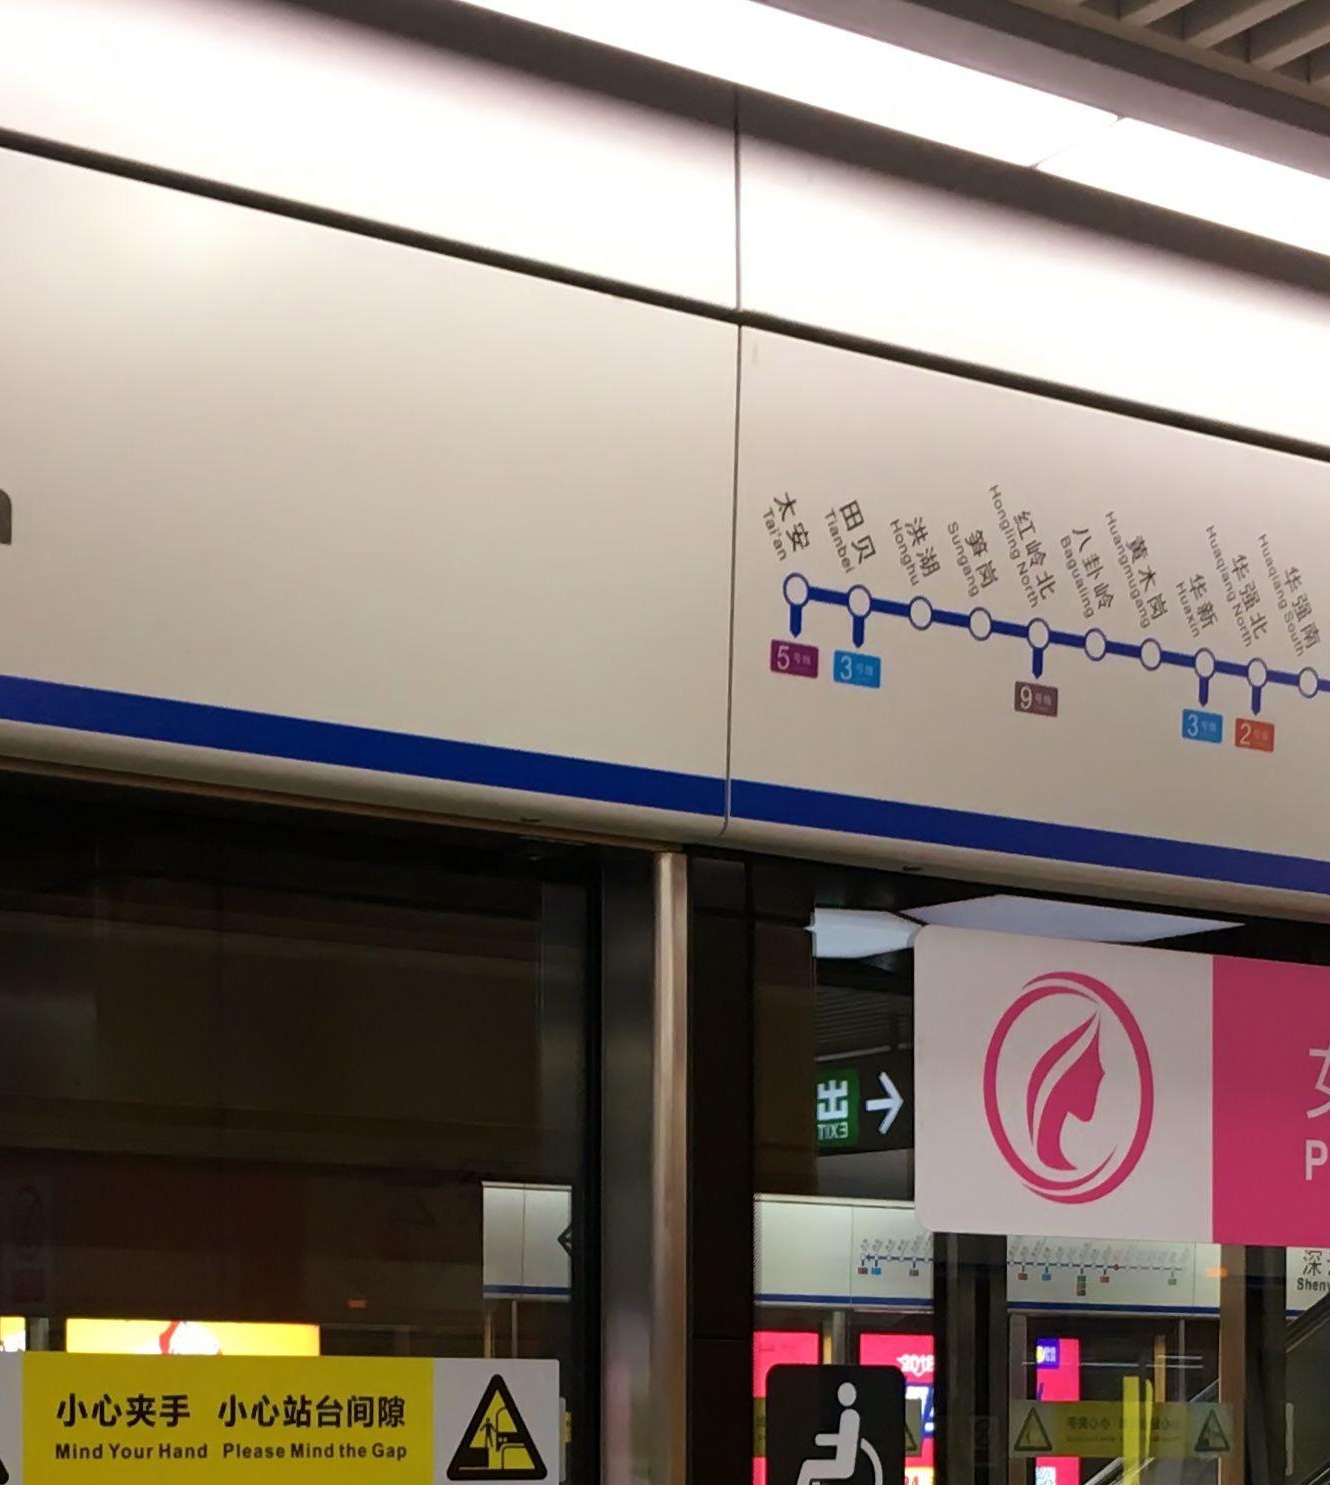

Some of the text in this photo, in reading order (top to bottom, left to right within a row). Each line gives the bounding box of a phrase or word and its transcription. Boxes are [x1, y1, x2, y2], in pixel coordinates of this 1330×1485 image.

[763, 507, 787, 561] Tai'an
[773, 492, 810, 551] 太安
[824, 508, 855, 573] Tianbei
[839, 500, 876, 564] 田贝
[890, 519, 919, 586] Honghu
[905, 517, 940, 577] 洪湖
[947, 521, 979, 598] Sungang
[989, 484, 1040, 609] Hongling North
[1013, 511, 1057, 600] 红岭北
[1060, 535, 1095, 619] Bagualing
[1072, 528, 1114, 610] 八卦岭
[1105, 511, 1150, 629] Huangmugang
[1126, 535, 1168, 620] 黄木岗
[1190, 573, 1218, 629] 华新
[1206, 525, 1253, 648] Huaqiang North
[1232, 554, 1269, 640] 华强北
[1258, 534, 1305, 658] Huaqiang South
[1176, 581, 1201, 638] Huaxin
[1285, 566, 1320, 650] 华强南
[57, 1393, 406, 1428] 小心夹手 小心站台间隙
[56, 1442, 407, 1461] Mind Your Hand Please Mind the Gap
